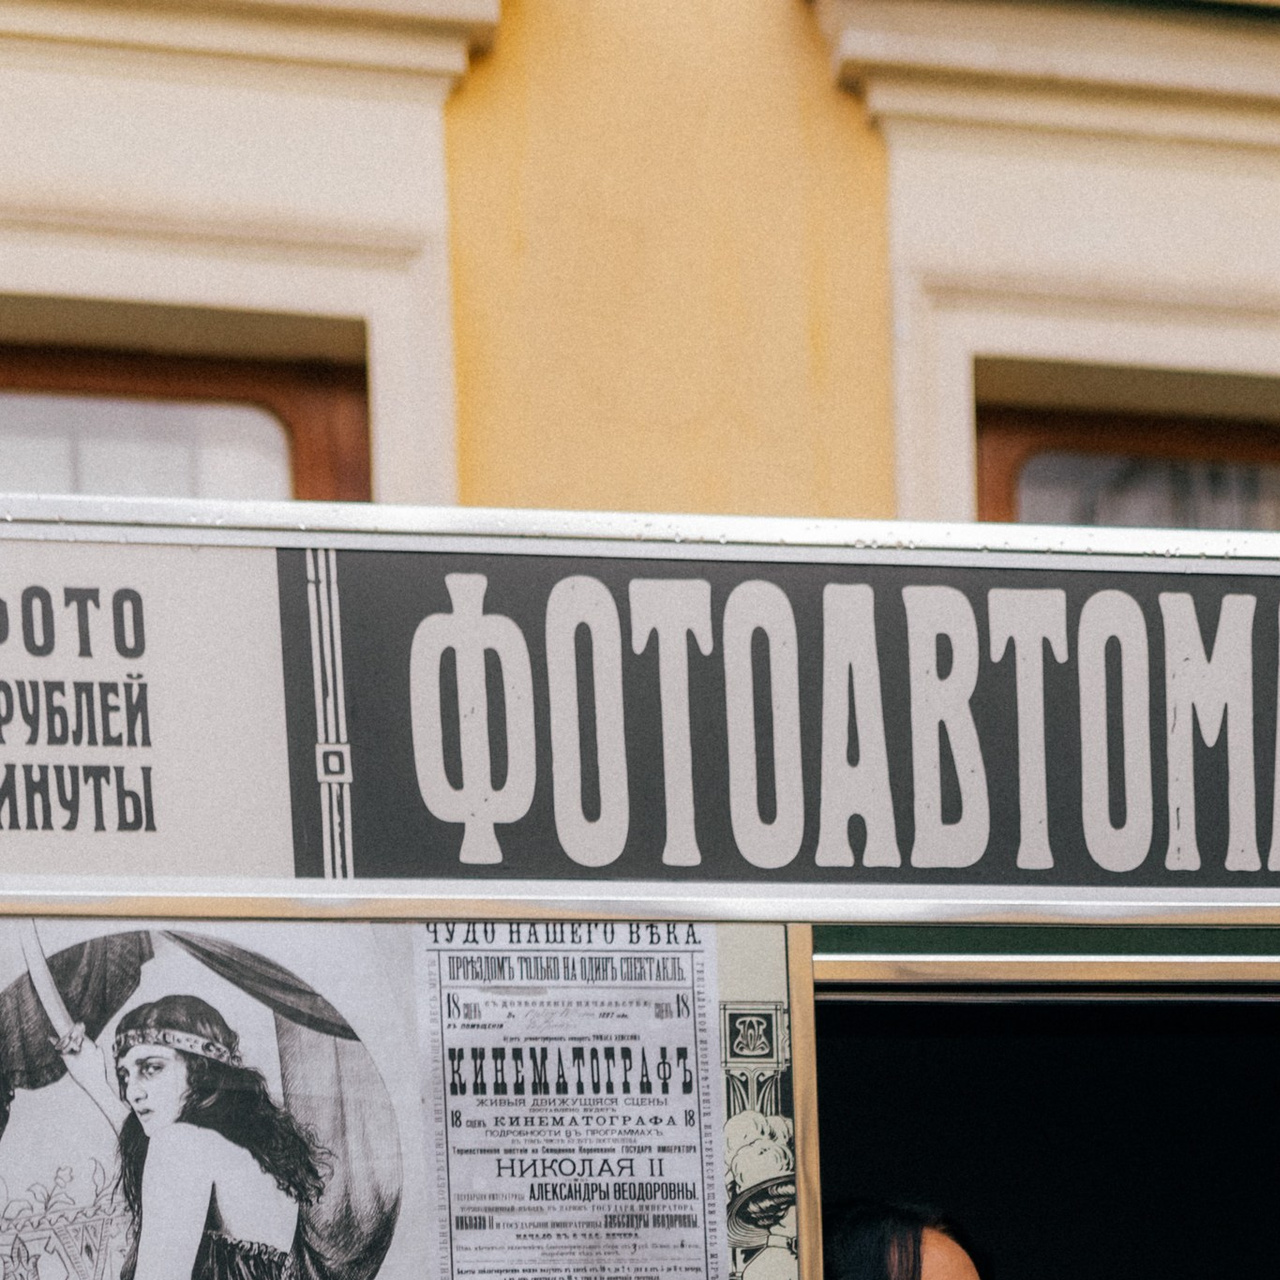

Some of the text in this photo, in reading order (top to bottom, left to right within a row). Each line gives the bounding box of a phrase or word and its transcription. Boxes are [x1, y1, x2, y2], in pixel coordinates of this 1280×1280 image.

[0, 584, 146, 659] ОТО
[426, 922, 496, 945] ЧУДО
[508, 922, 615, 945] НАШЕГО
[517, 956, 560, 981] ТОЛЬКО
[563, 957, 577, 981] НА
[580, 957, 617, 984] ОДИНЪ
[447, 992, 461, 1019] 18
[676, 993, 690, 1019] 18
[448, 1047, 693, 1096] КИНЕМАТОГРАФЪ
[624, 1097, 668, 1107] СЦЕНЫ
[451, 1109, 695, 1128] 18 КИНЕМАТОГРАФА 18
[495, 1158, 635, 1178] НИКОЛАЯ
[529, 1183, 611, 1202] АЛЕКСАНДРЫ
